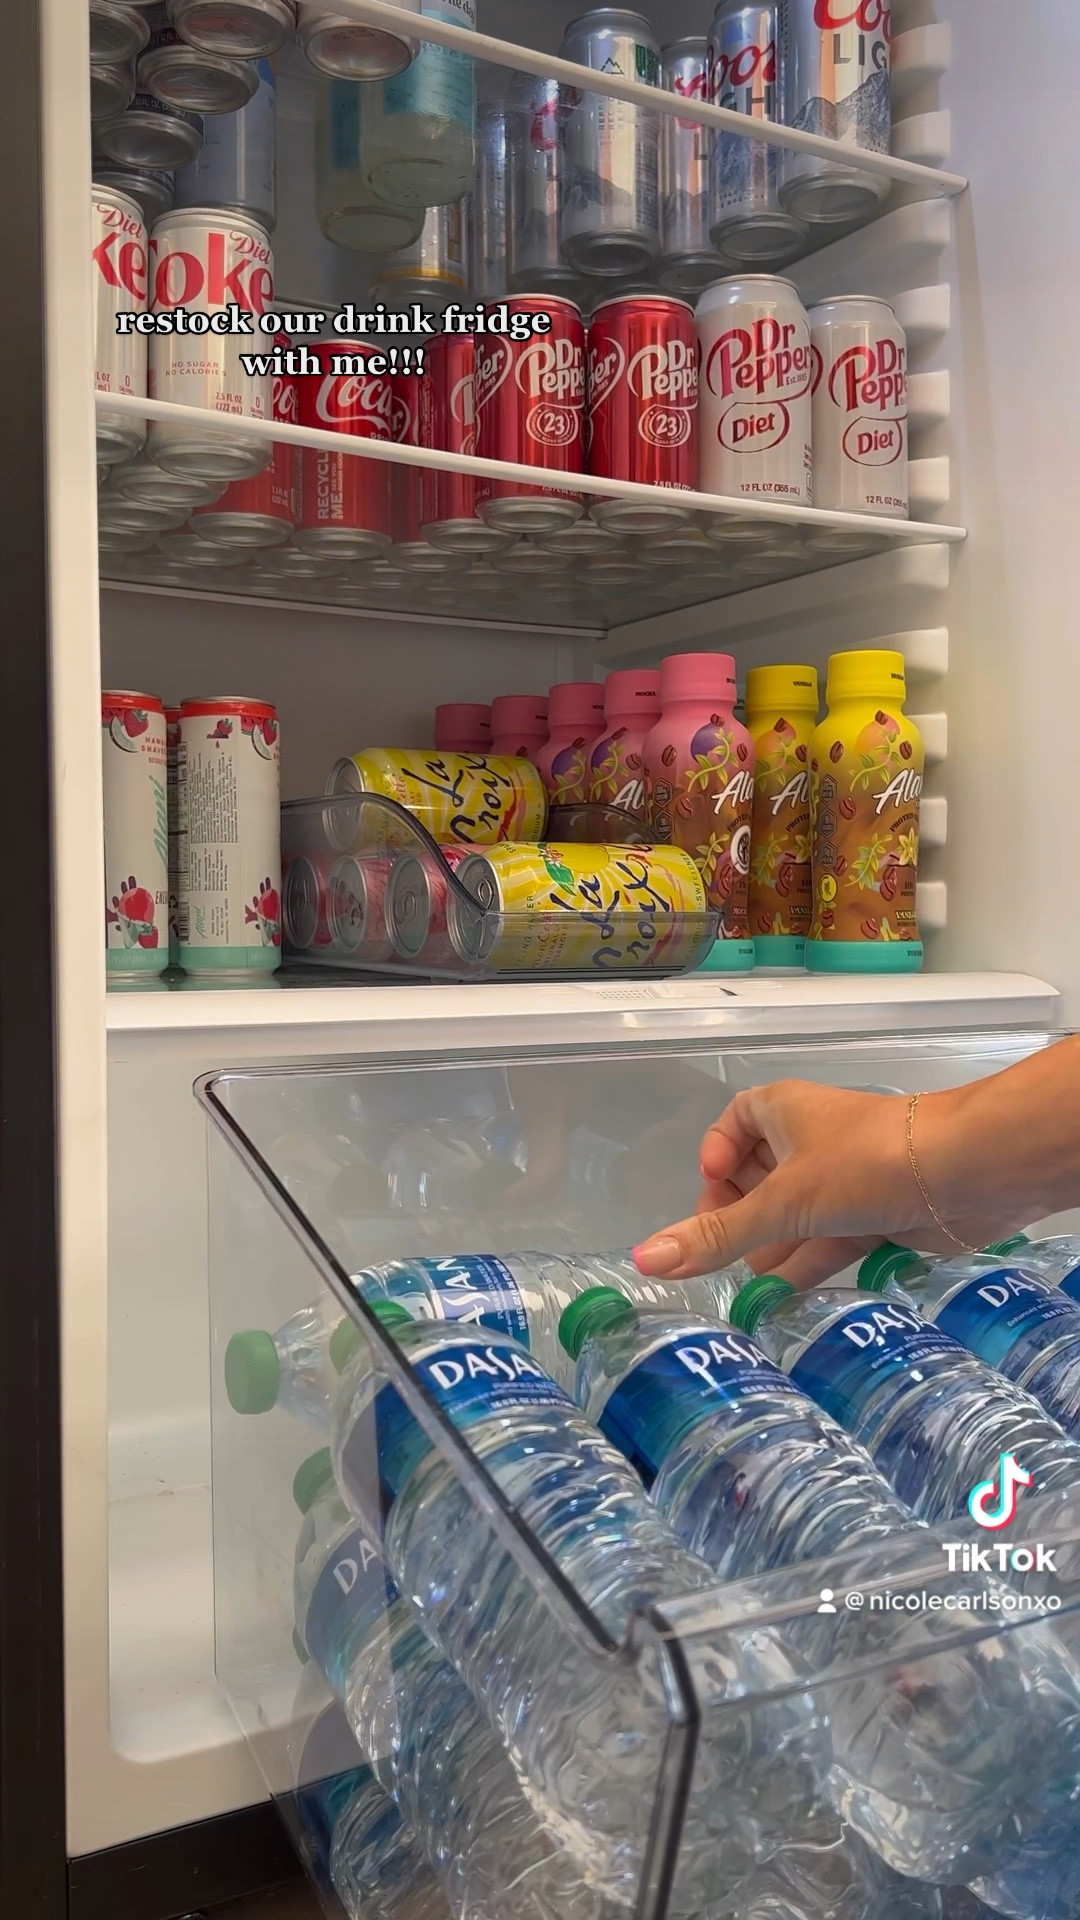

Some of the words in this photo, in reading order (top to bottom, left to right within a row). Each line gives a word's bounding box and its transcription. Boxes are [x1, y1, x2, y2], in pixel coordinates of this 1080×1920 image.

[97, 203, 143, 239] Diet
[229, 231, 271, 265] Diet
[555, 338, 582, 370] Dr
[752, 318, 796, 357] Dr
[171, 361, 184, 369] NO
[186, 361, 219, 369] SUGAR
[667, 339, 695, 372] Dr
[706, 328, 810, 400] Pepper
[876, 338, 906, 373] Dr
[180, 369, 227, 377] CALORIES
[543, 411, 566, 435] 23
[655, 413, 678, 437] 23
[731, 410, 776, 444] Diet
[857, 429, 894, 455] Diet
[740, 483, 751, 492] 12
[751, 483, 762, 492] FL
[763, 483, 773, 492] OZ
[773, 483, 789, 493] (355
[866, 495, 875, 504] 12
[875, 495, 884, 505] FL
[884, 497, 893, 506] OZ
[330, 492, 344, 520] ME
[400, 758, 465, 808] La
[450, 754, 512, 844] Croix
[549, 874, 621, 940] La
[592, 861, 671, 968] Croix
[488, 1283, 506, 1320] PURIFIED
[512, 1295, 522, 1307] OZ
[517, 1315, 527, 1331] 16.9
